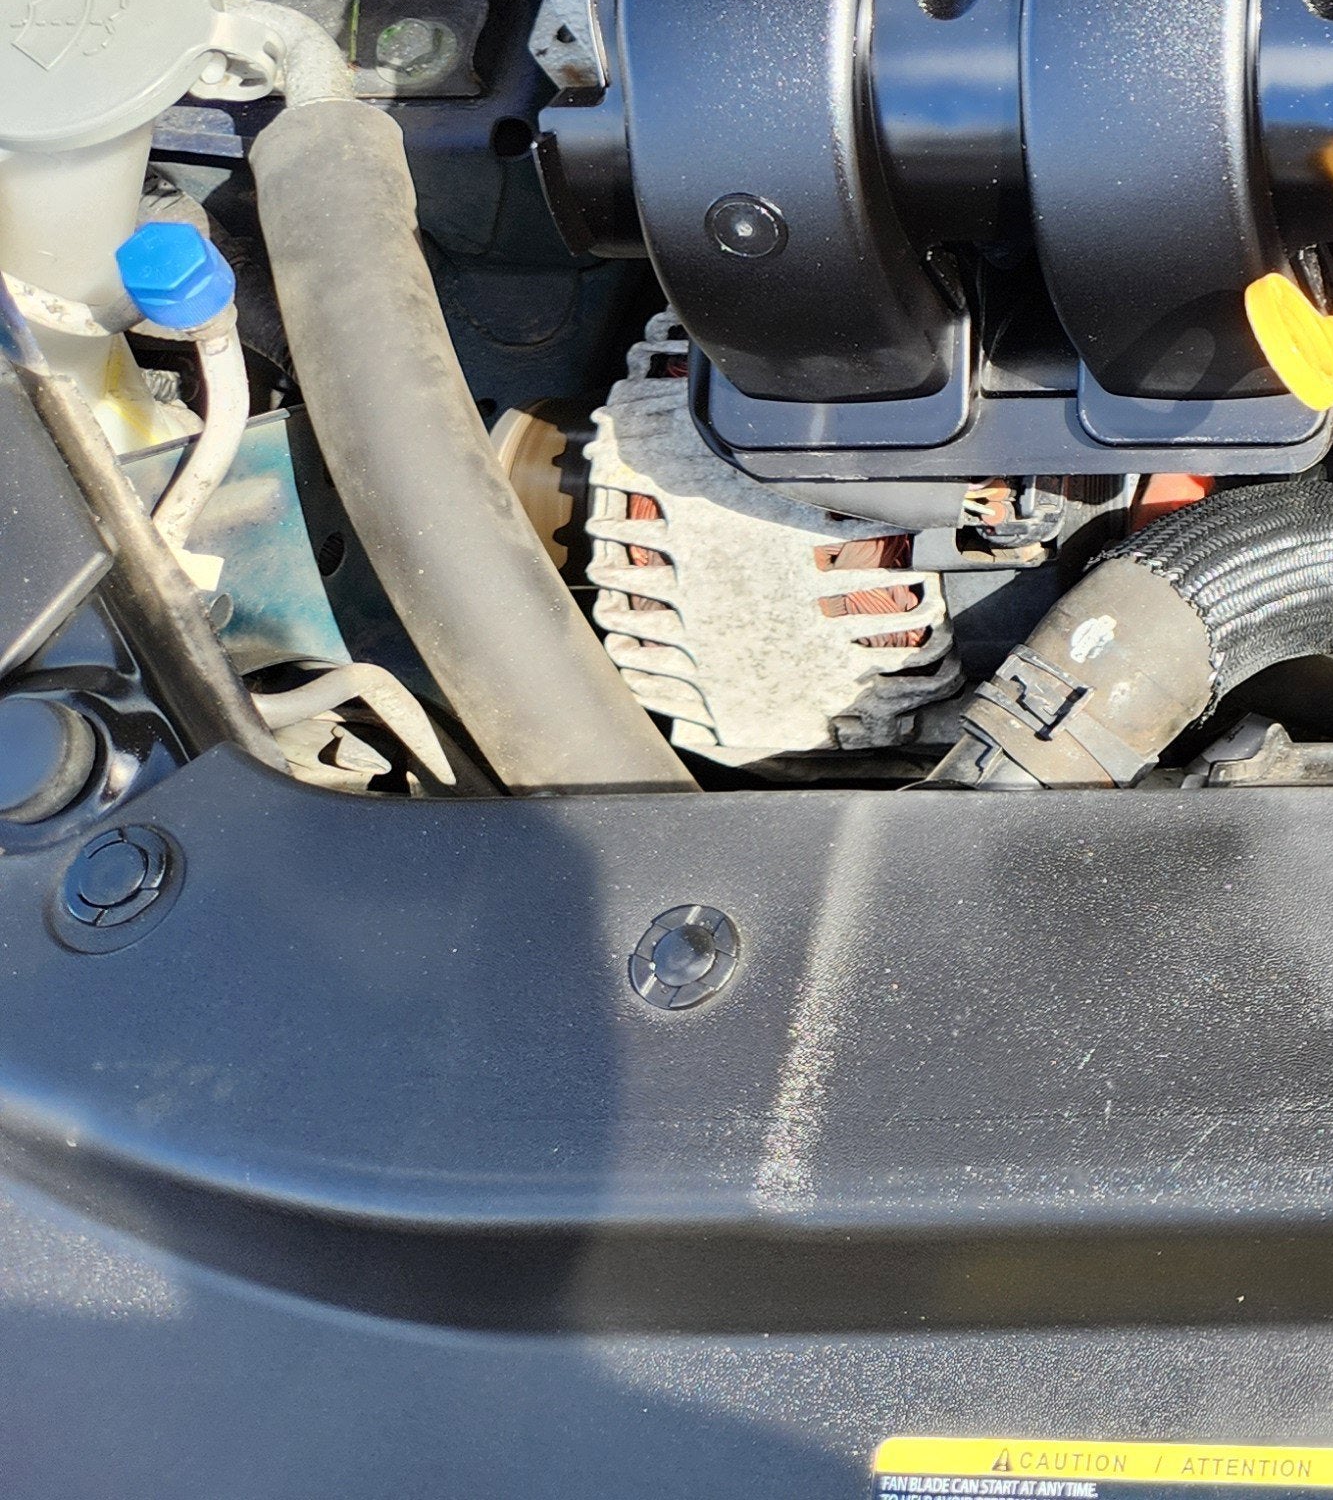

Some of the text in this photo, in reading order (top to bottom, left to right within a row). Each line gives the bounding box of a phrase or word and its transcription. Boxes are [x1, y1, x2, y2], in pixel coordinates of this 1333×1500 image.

[1020, 1451, 1312, 1478] CAUTION / ATTENTION
[881, 1476, 908, 1491] FAN
[909, 1477, 951, 1492] BLADE
[951, 1479, 979, 1493] CAN
[979, 1479, 1020, 1494] START
[1018, 1480, 1037, 1494] AT
[1036, 1481, 1065, 1496] ANY
